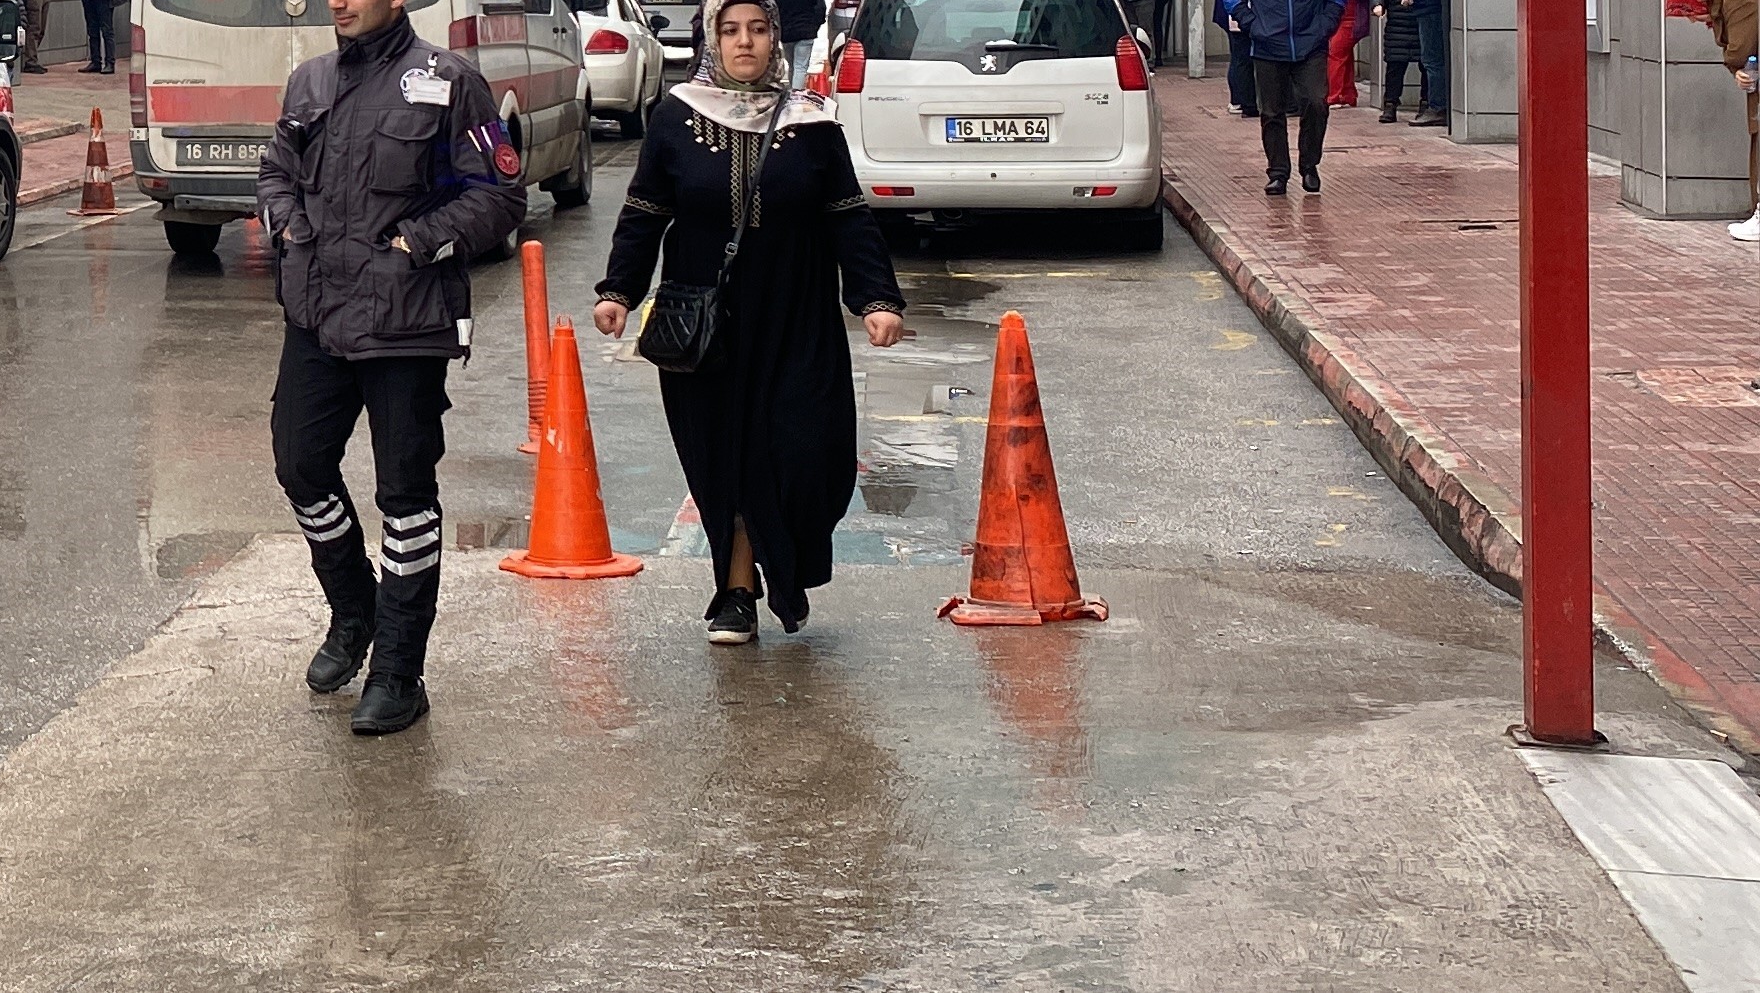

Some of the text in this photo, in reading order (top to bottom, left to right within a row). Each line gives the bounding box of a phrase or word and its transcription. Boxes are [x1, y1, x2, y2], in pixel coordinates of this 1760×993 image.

[957, 120, 1046, 136] 16 LMA 64
[186, 144, 202, 159] 16
[209, 144, 233, 159] RH
